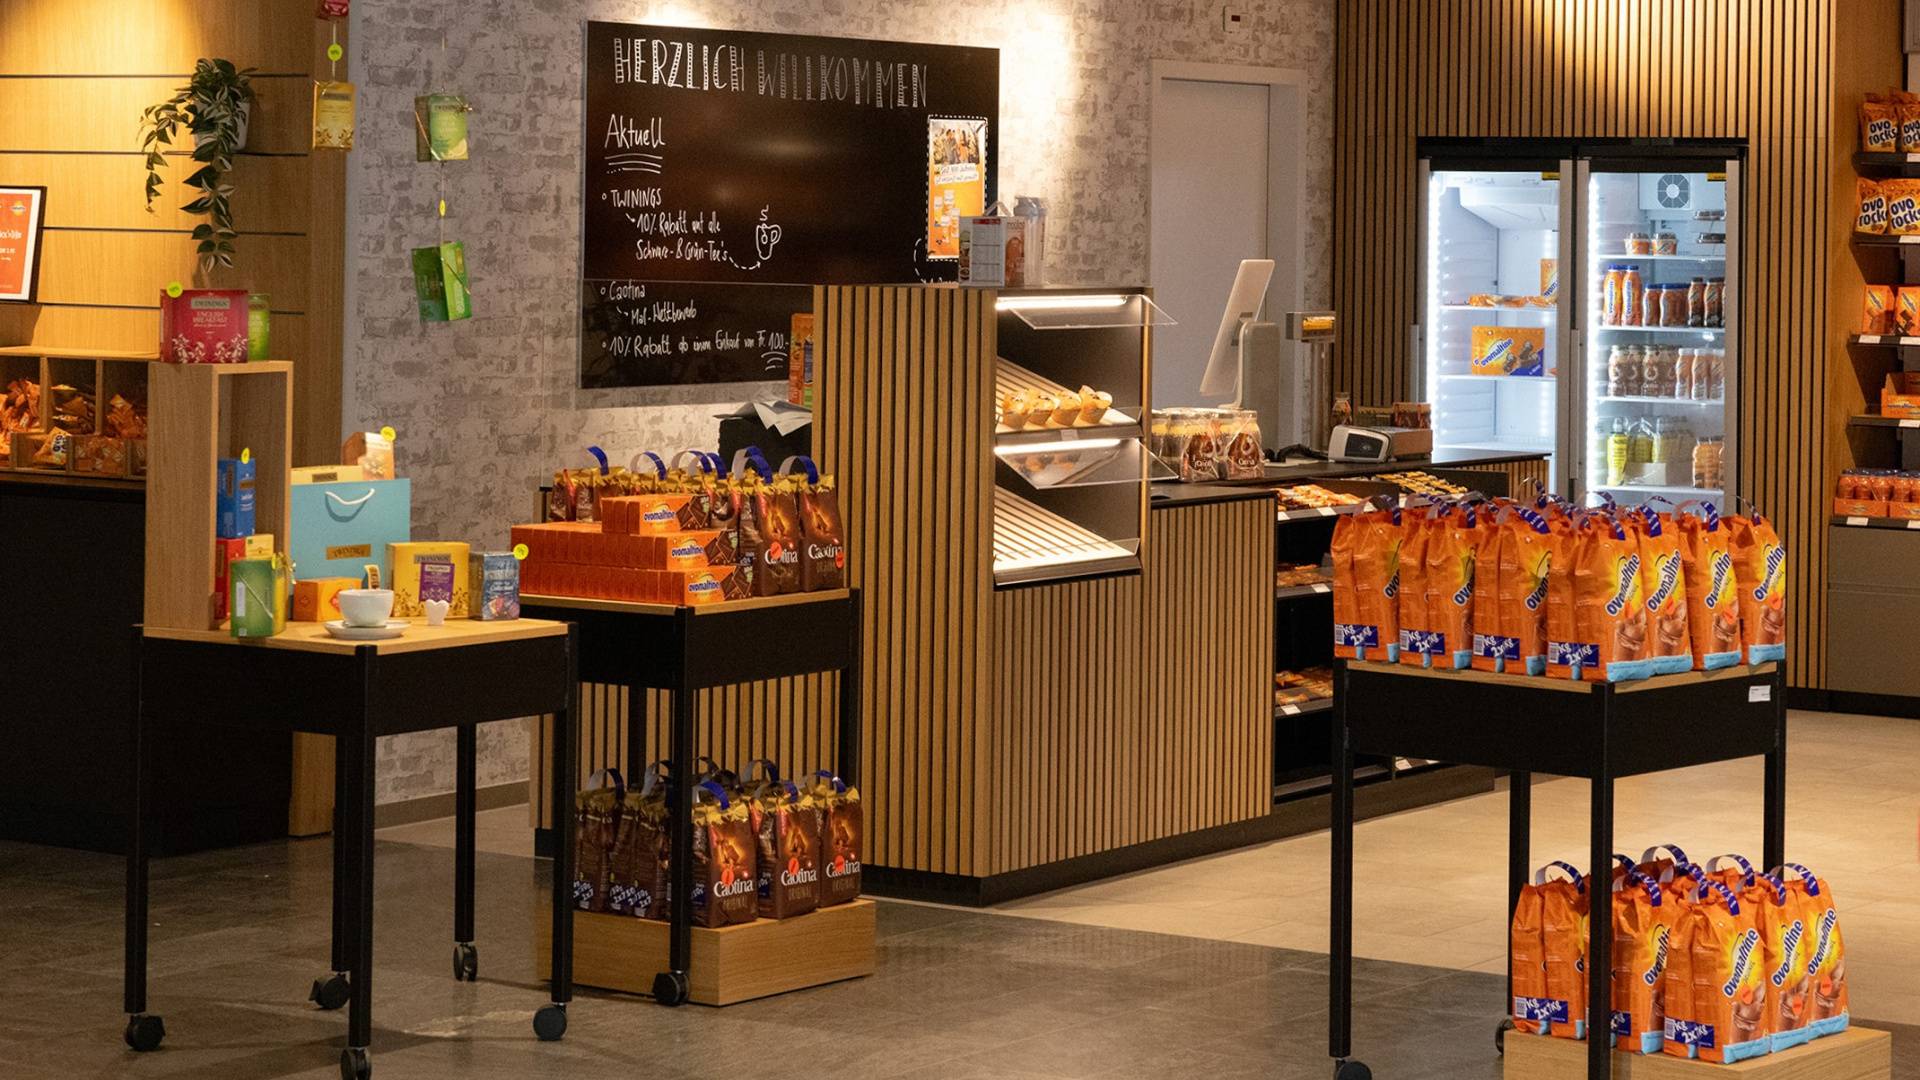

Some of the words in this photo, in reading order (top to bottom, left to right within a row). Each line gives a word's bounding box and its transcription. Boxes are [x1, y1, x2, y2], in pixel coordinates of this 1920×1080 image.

[614, 37, 745, 91] HERZLICH
[757, 49, 927, 109] WILLKOMMEN
[604, 113, 666, 149] Aktuell
[610, 187, 662, 209] TWININGS
[637, 212, 656, 235] 10%
[659, 209, 688, 237] Rabatt
[609, 335, 632, 357] 10%
[633, 334, 672, 358] Rabatt
[1724, 929, 1759, 996] ovomaltine
